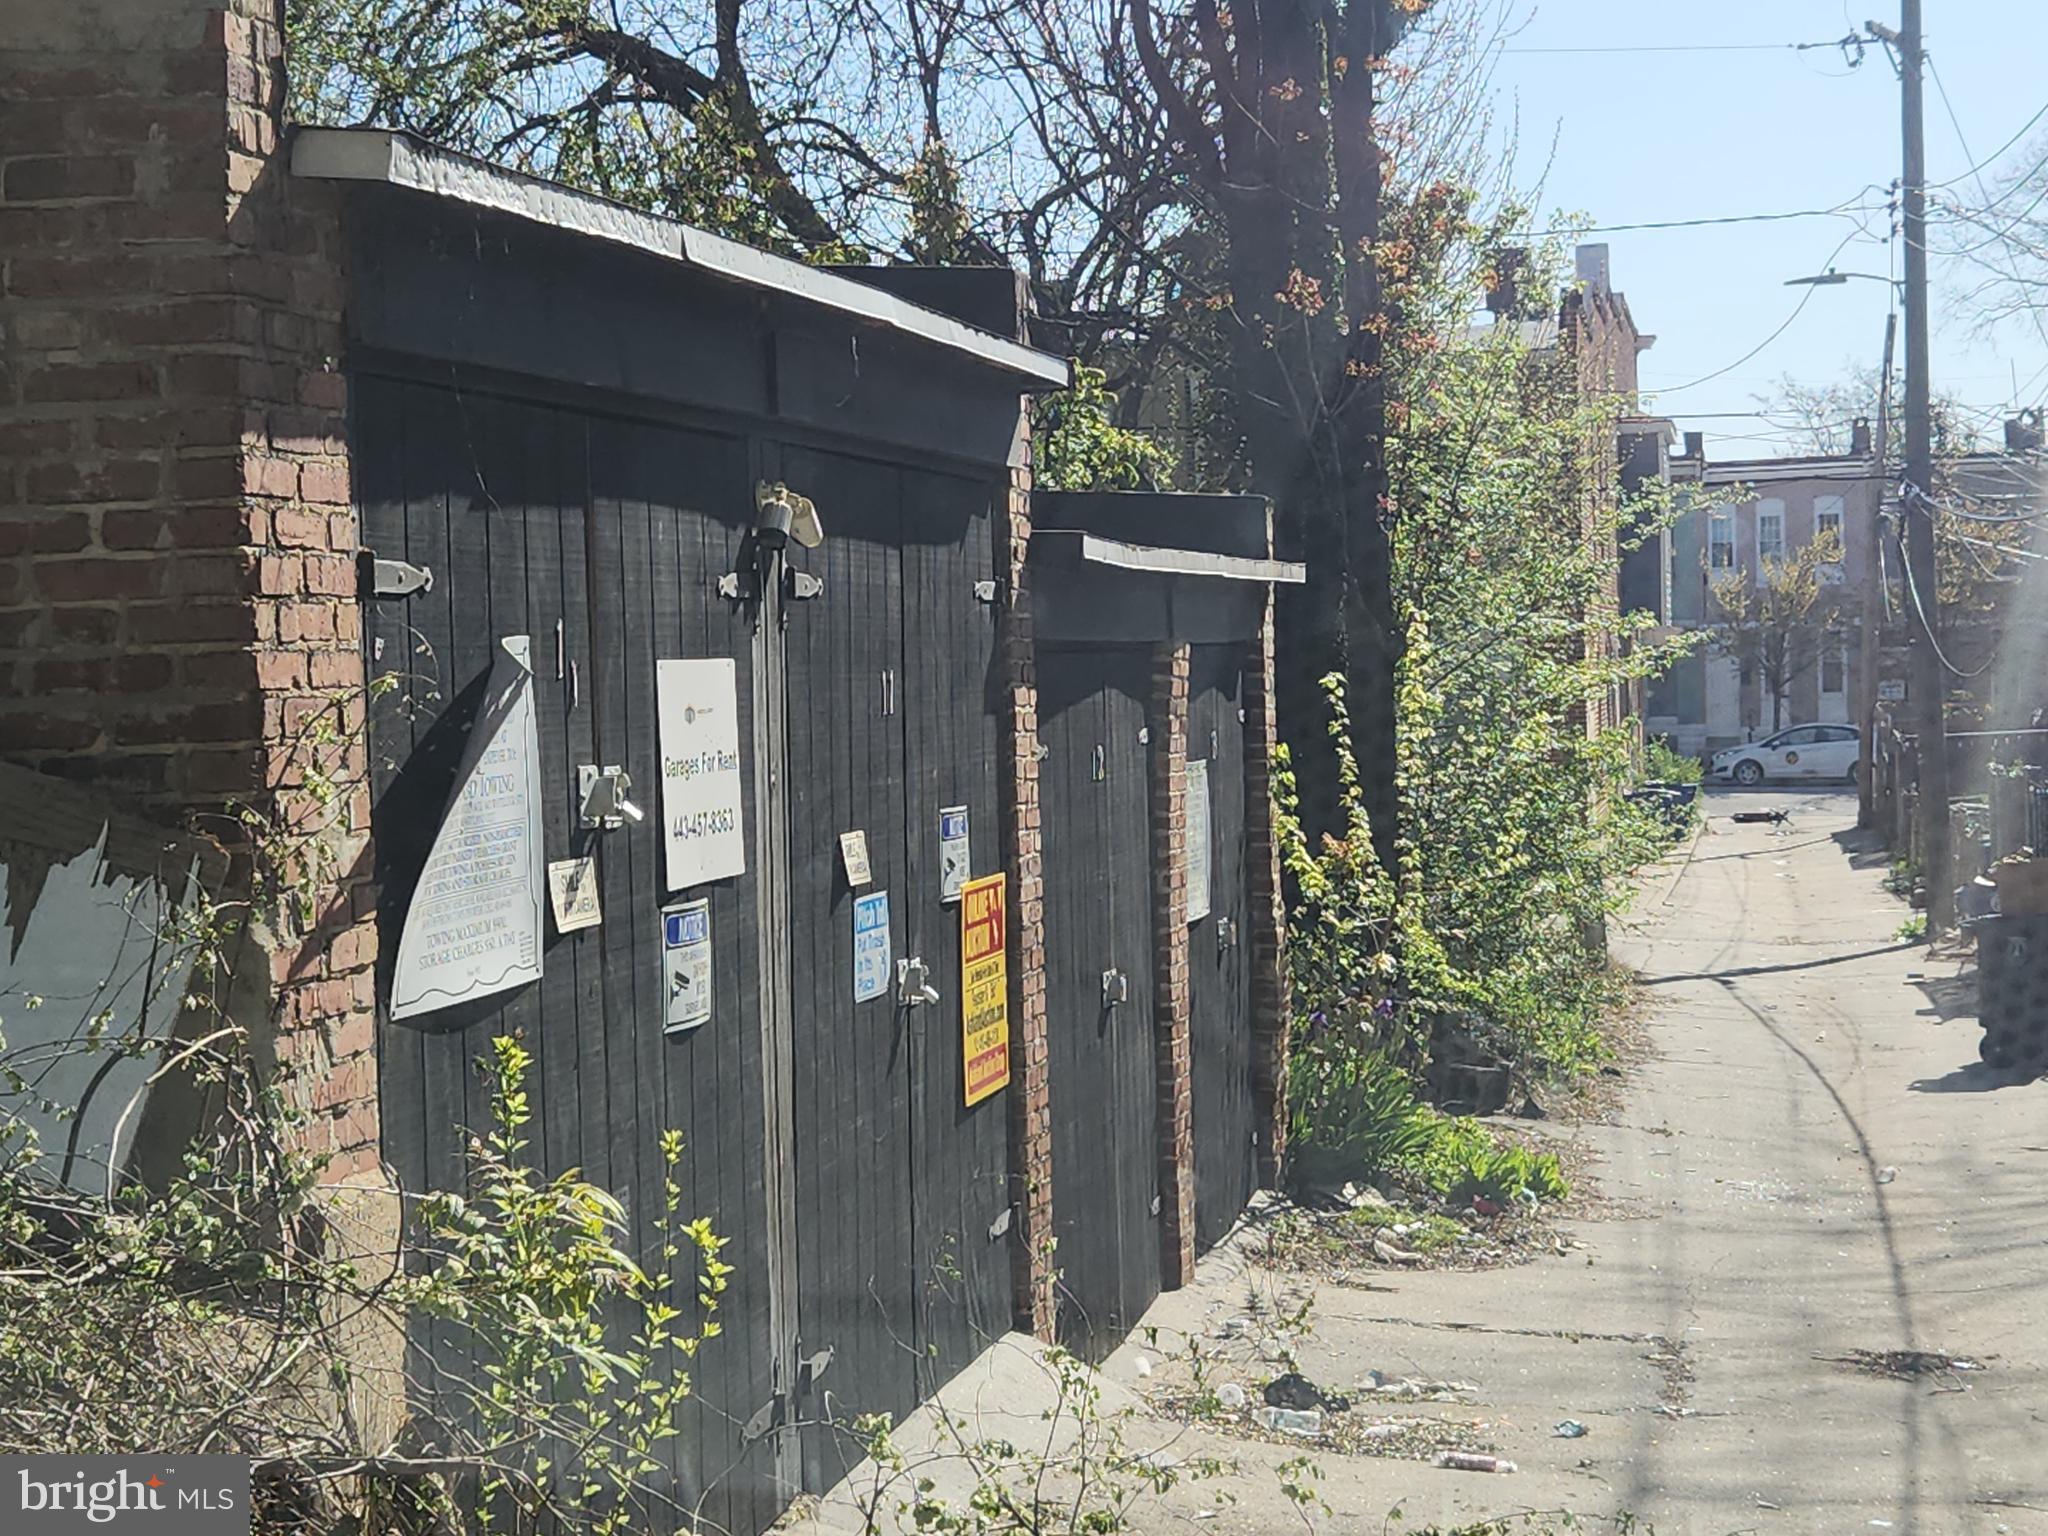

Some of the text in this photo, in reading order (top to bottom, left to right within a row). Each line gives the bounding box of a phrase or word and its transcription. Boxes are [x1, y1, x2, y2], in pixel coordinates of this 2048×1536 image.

[665, 749, 737, 781] Garages For Rent
